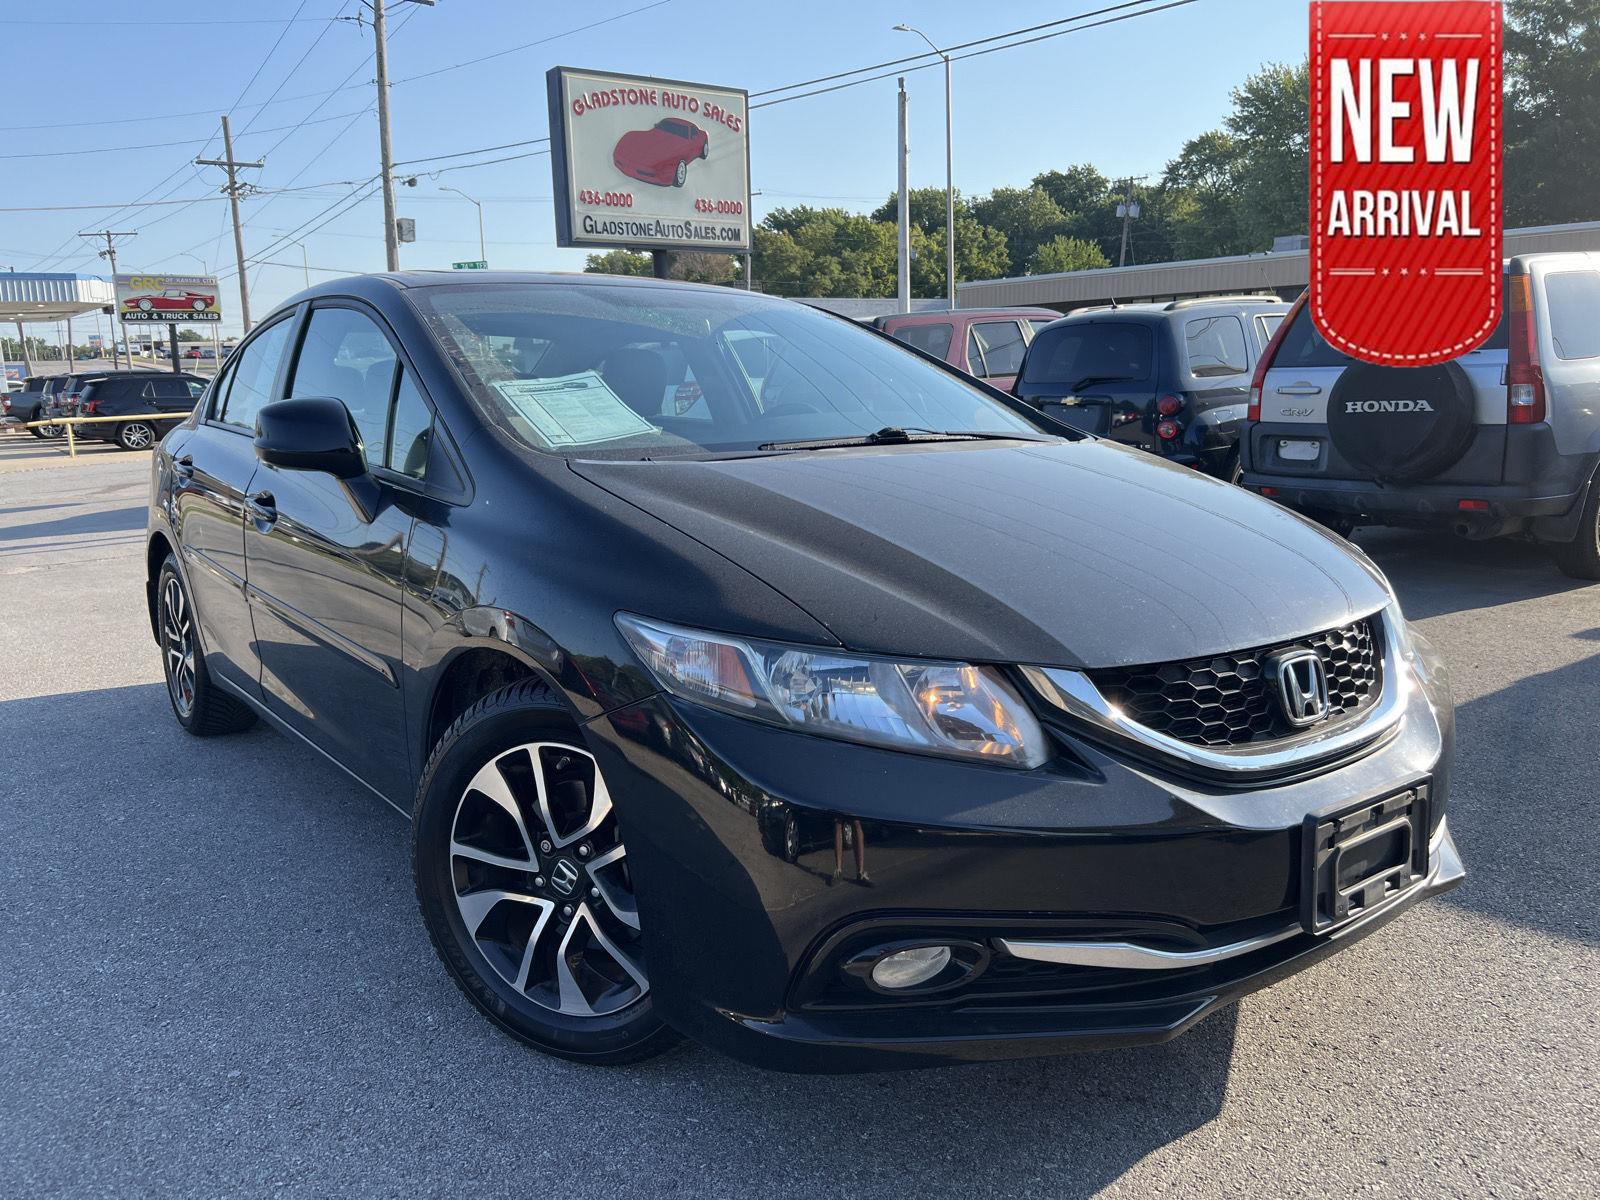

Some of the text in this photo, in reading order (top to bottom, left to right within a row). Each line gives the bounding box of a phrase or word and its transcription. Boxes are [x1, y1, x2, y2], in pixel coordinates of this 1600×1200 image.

[573, 88, 742, 133] GLADSTONE AUTO SALES
[579, 190, 633, 208] 436-0000
[694, 199, 743, 215] 436-0000
[583, 215, 741, 242] GLADSTONEAUTOSALES.COM
[130, 276, 166, 290] GRC
[1280, 407, 1314, 417] CR-V
[1345, 399, 1434, 413] HONDA
